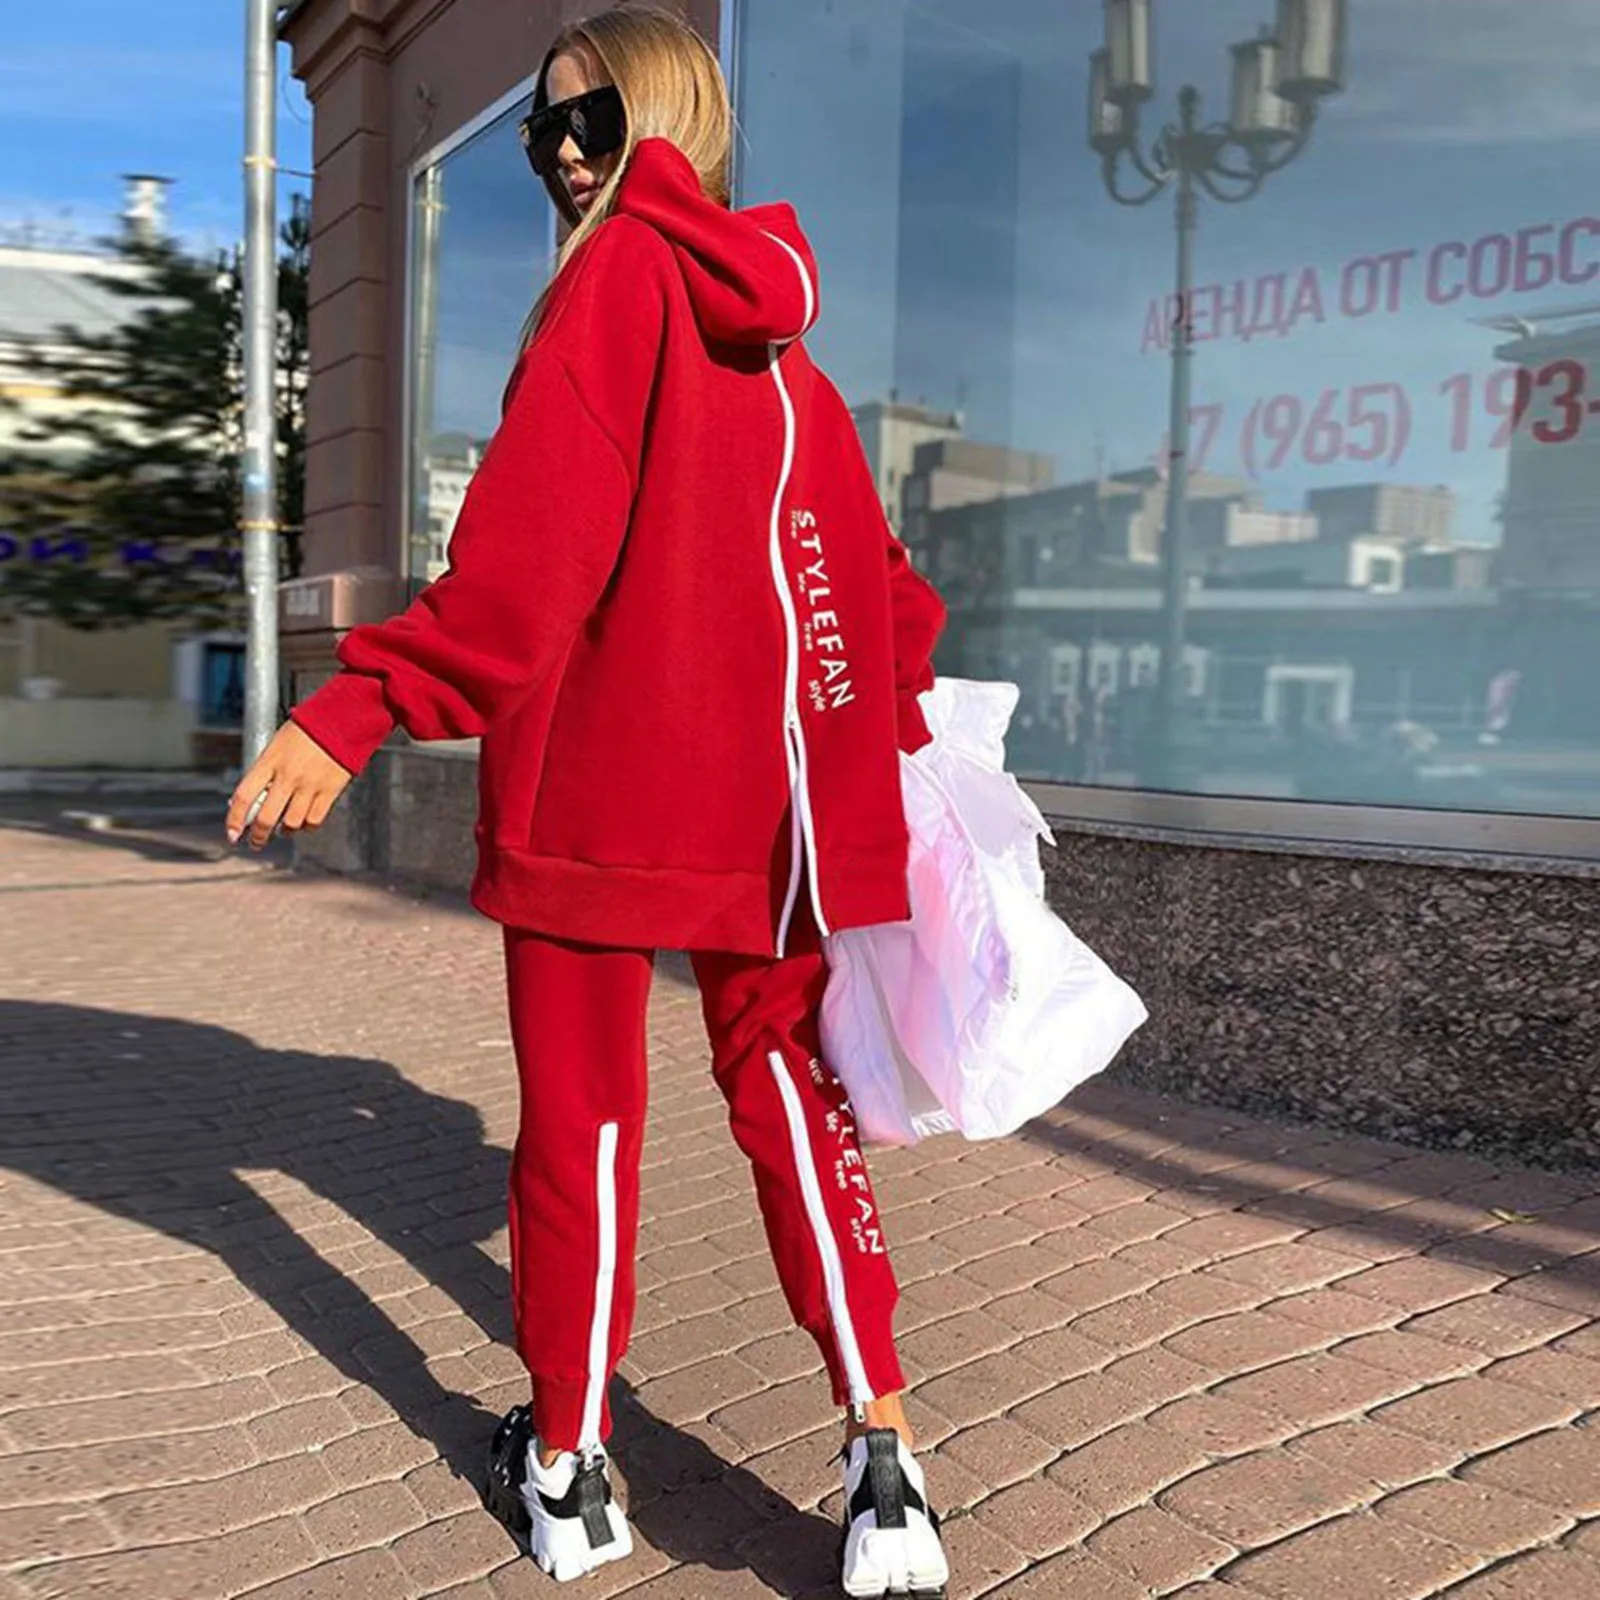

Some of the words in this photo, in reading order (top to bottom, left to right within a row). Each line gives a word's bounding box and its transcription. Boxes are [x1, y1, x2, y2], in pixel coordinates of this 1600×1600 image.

[1139, 268, 1326, 355] АРЕНДА
[1338, 248, 1415, 318] ОТ
[1425, 216, 1600, 306] СОБС
[1240, 382, 1413, 479] (965)
[798, 510, 856, 709] STYLEFAN
